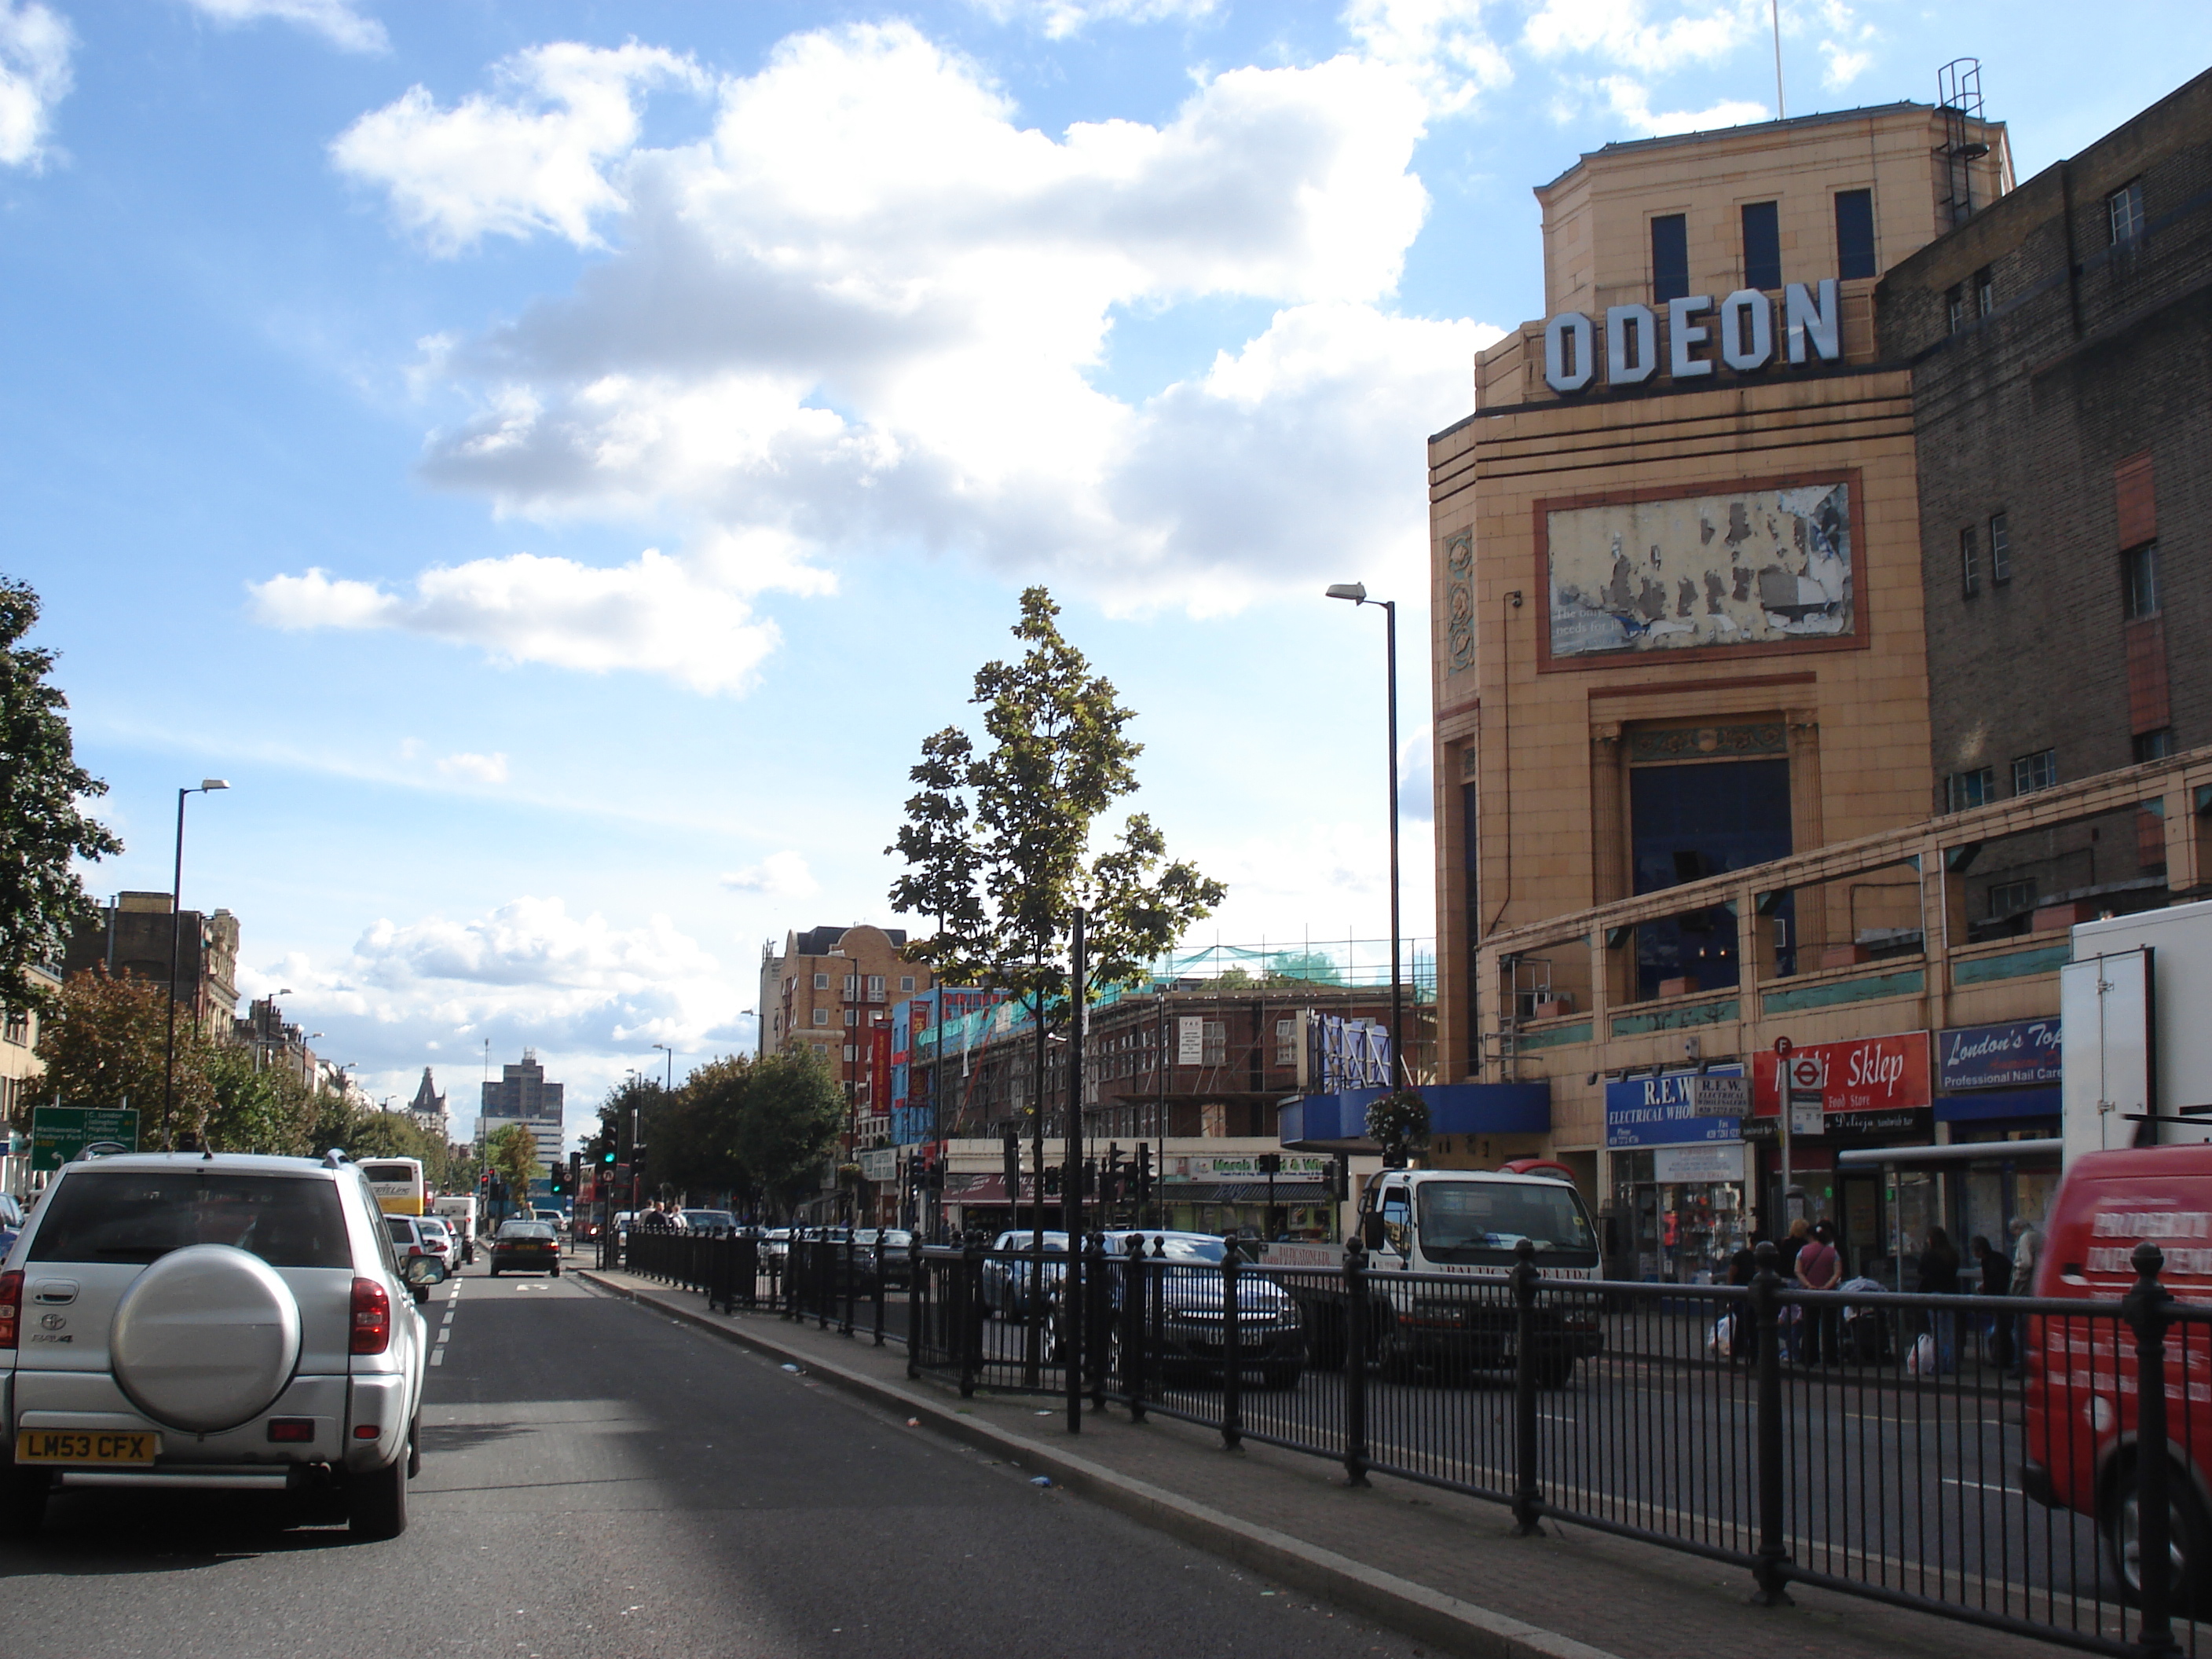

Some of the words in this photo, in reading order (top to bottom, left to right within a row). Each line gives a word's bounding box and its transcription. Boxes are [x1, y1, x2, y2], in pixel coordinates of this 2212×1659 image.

[1545, 278, 1841, 394] ODEON
[1778, 1039, 1788, 1053] F
[1947, 1029, 2023, 1067] London's
[1848, 1043, 1903, 1097] Sklep
[1944, 1071, 2009, 1087] Professional
[2012, 1068, 2034, 1082] Nail
[1702, 1080, 1741, 1092] R.E.W.
[1828, 1094, 1846, 1108] Food
[1850, 1094, 1870, 1107] Store
[1610, 1107, 1663, 1125] ELECTRICAL
[31, 1335, 73, 1343] RAV4
[28, 1435, 90, 1458] LM53
[97, 1437, 145, 1459] CFX
